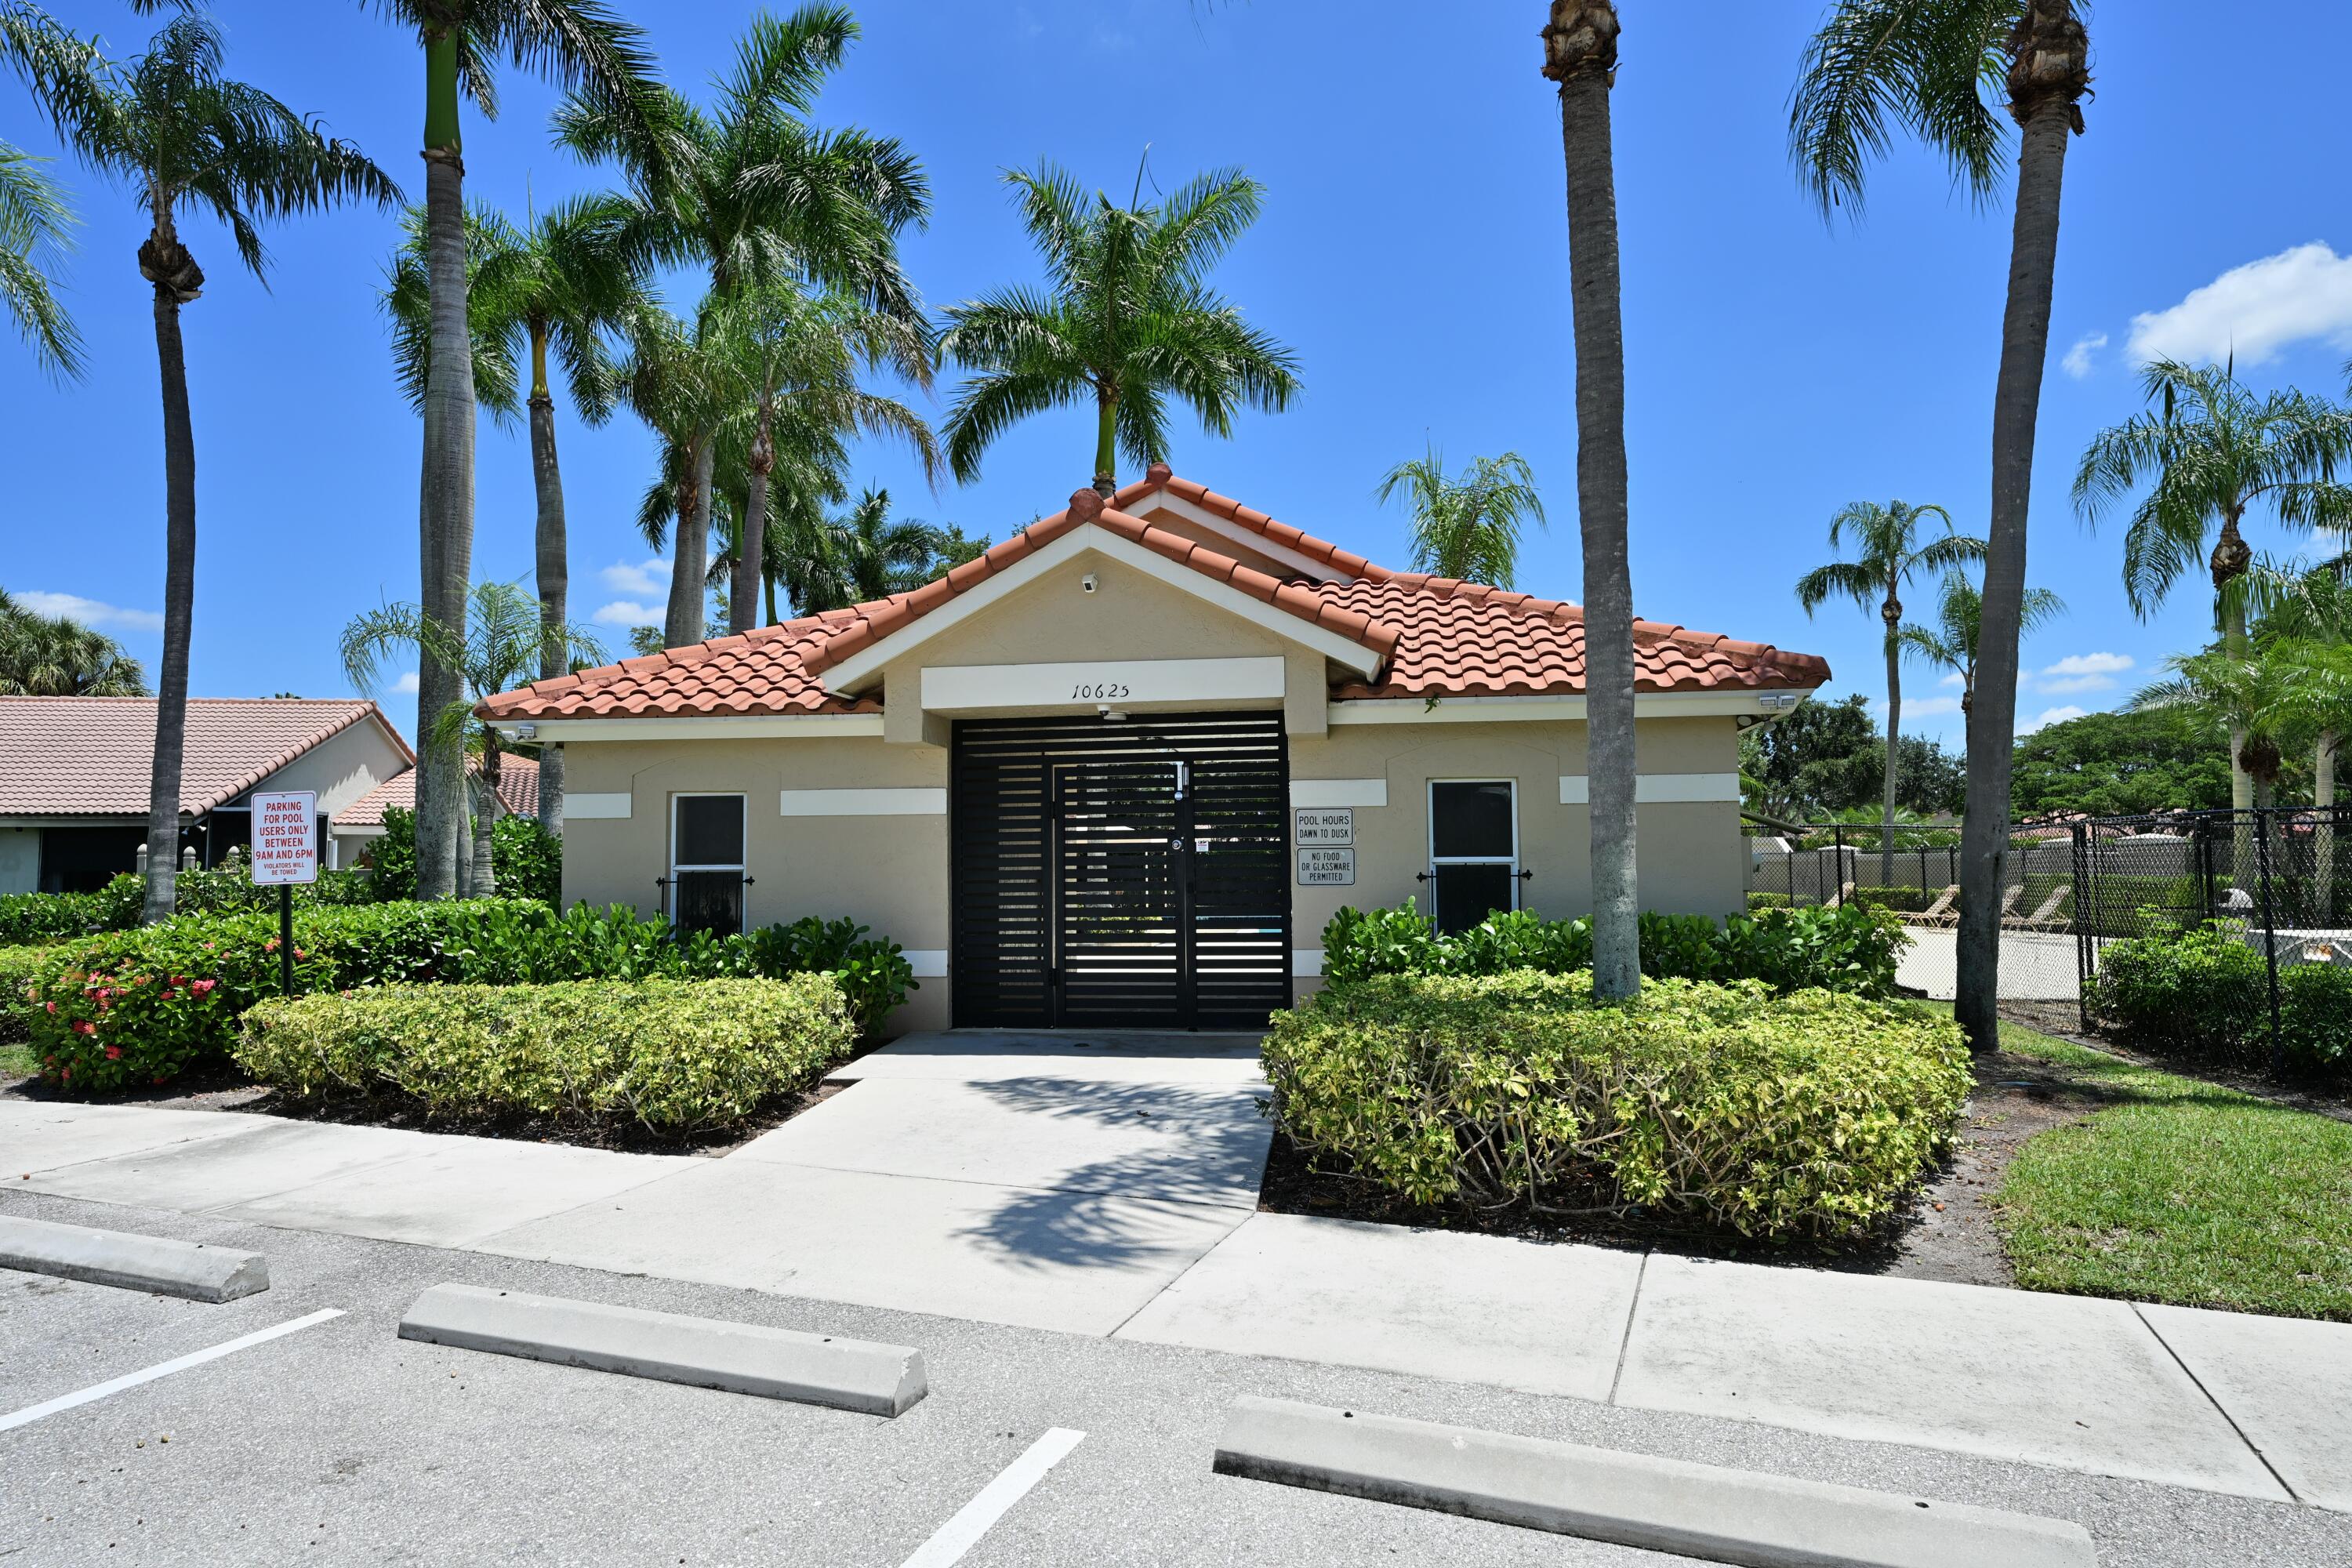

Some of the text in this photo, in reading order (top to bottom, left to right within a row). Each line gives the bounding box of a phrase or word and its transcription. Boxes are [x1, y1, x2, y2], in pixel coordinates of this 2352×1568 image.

[1072, 683, 1130, 699] 10625
[267, 801, 302, 811] PARKING
[264, 813, 304, 824] FOR POOL
[1298, 815, 1349, 826] POOL HOURS
[260, 825, 309, 836] USERS ONLY
[1299, 829, 1349, 838] DAWN TO DUSK
[265, 837, 303, 848] BETWEEN
[256, 849, 313, 860] 9AM AND 6PM
[1312, 852, 1340, 861] NO FOOD
[1301, 862, 1351, 871] OR GLASSWARE
[1309, 873, 1343, 881] PERMITTED
